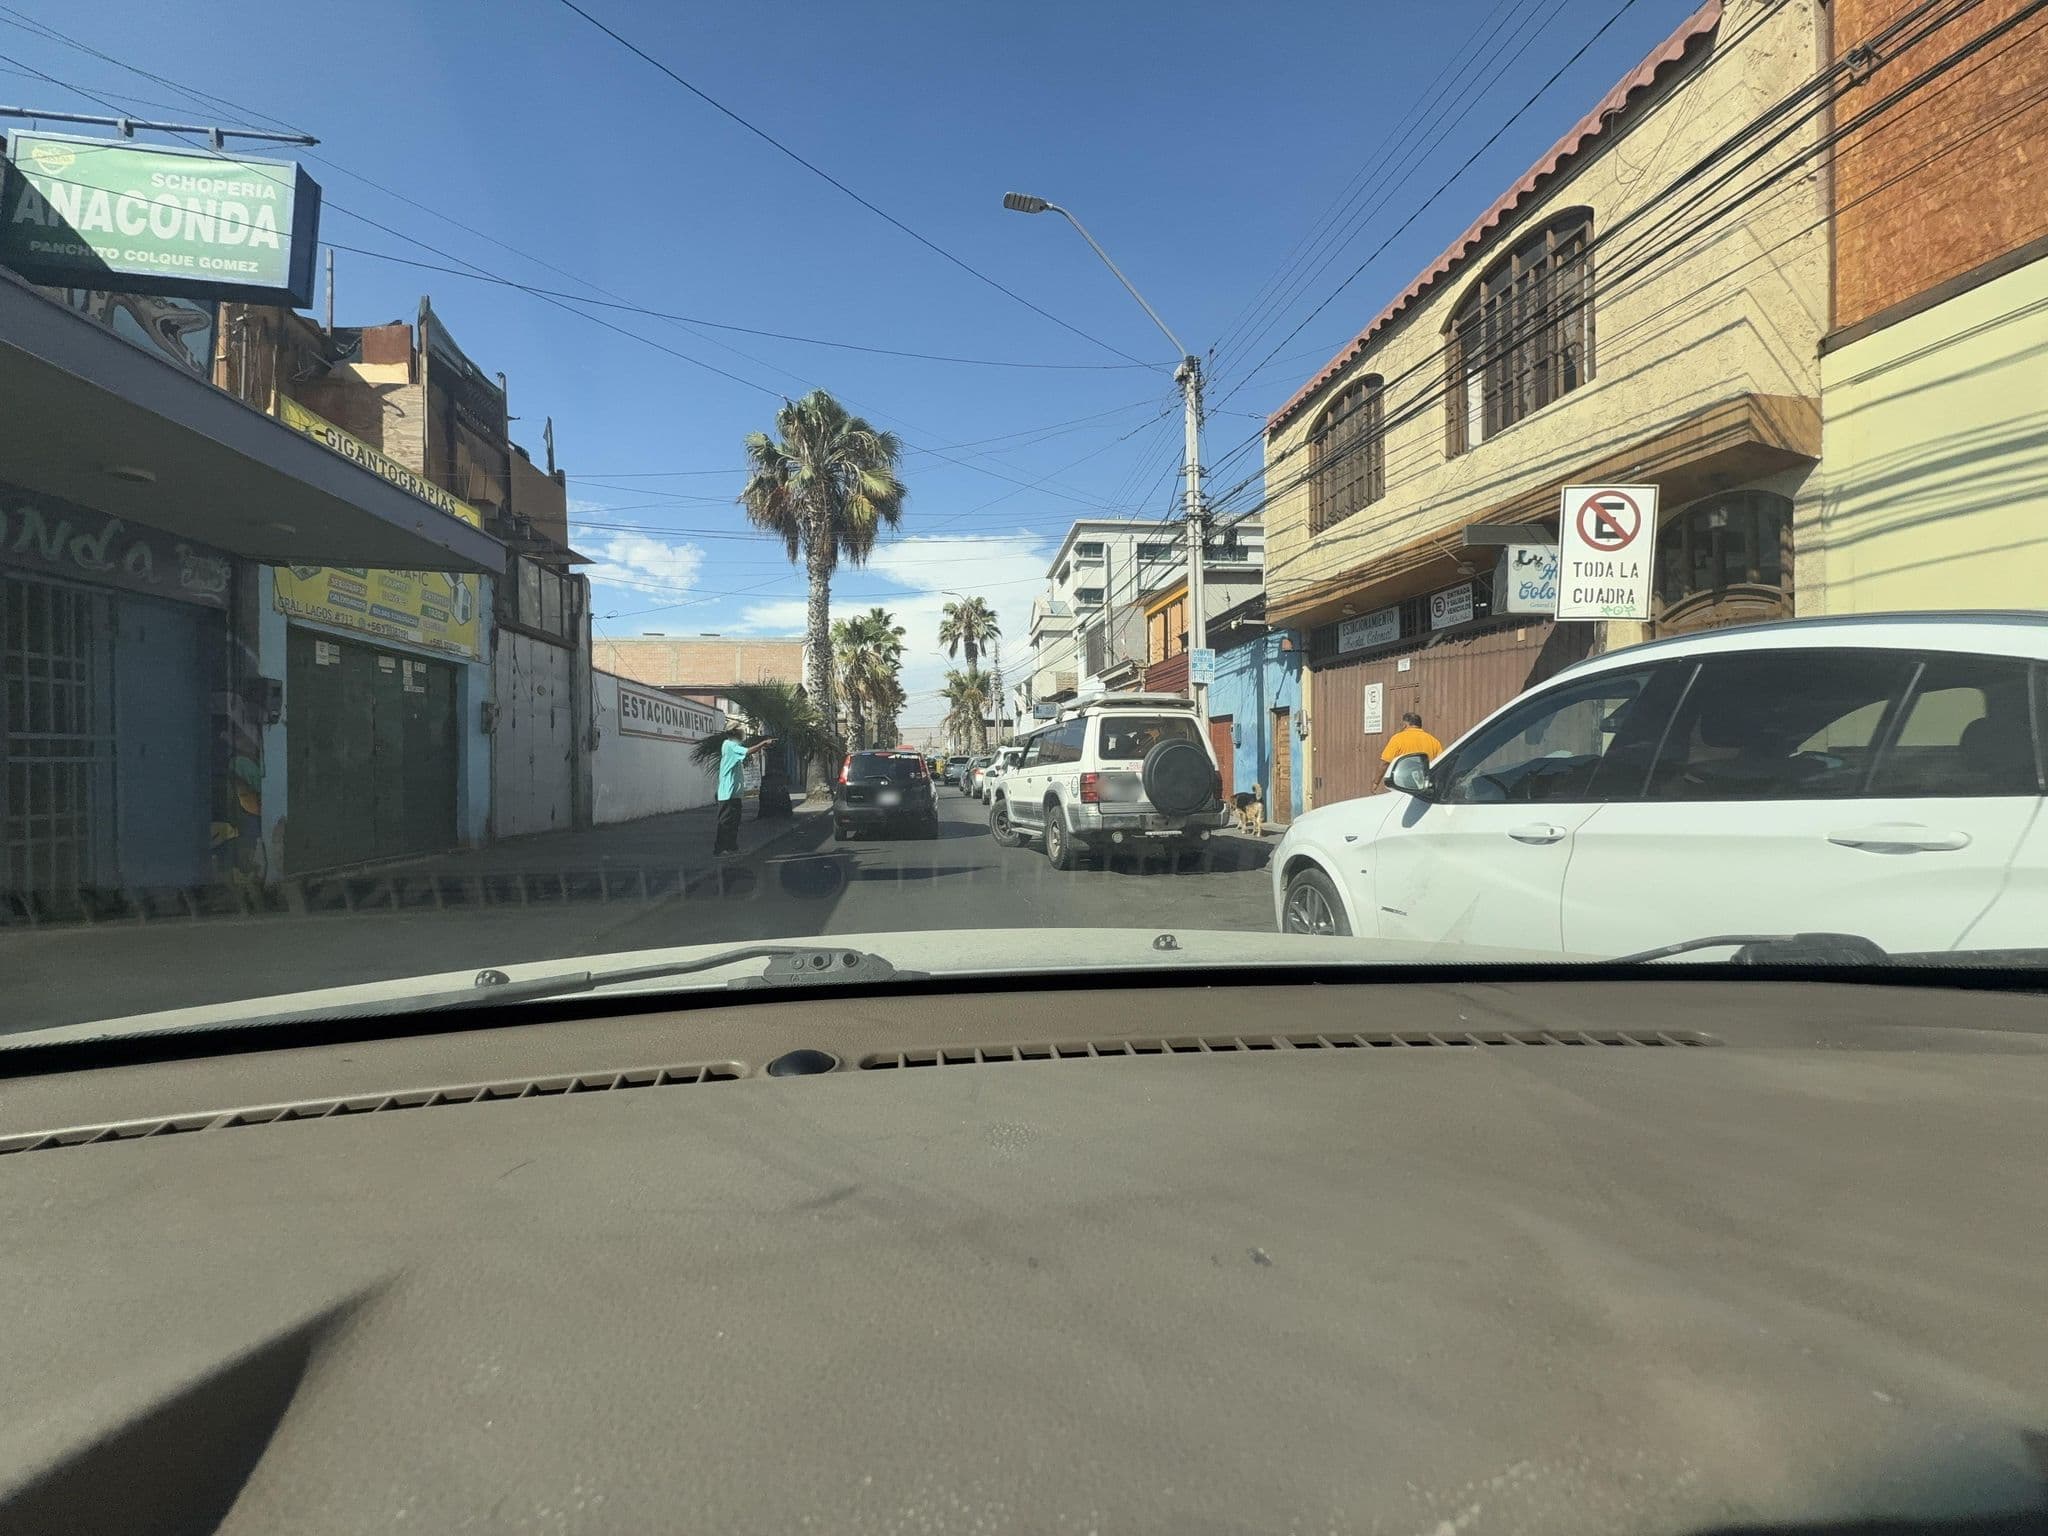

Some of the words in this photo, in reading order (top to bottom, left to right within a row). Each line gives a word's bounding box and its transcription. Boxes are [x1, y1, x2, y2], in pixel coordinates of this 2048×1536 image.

[151, 173, 277, 200] SCHOPERIA
[12, 180, 280, 249] ANACONDA
[30, 241, 119, 260] PANCHITO
[123, 249, 195, 268] COLQUE
[198, 256, 259, 274] GOMEZ
[324, 427, 457, 515] GIGANTOGRAFÍAS
[1573, 562, 1614, 578] TODA
[1620, 562, 1639, 578] LA
[1519, 581, 1556, 599] Colo
[1573, 588, 1635, 605] CUADRA
[621, 694, 715, 734] ESTACIONAMIENTO
